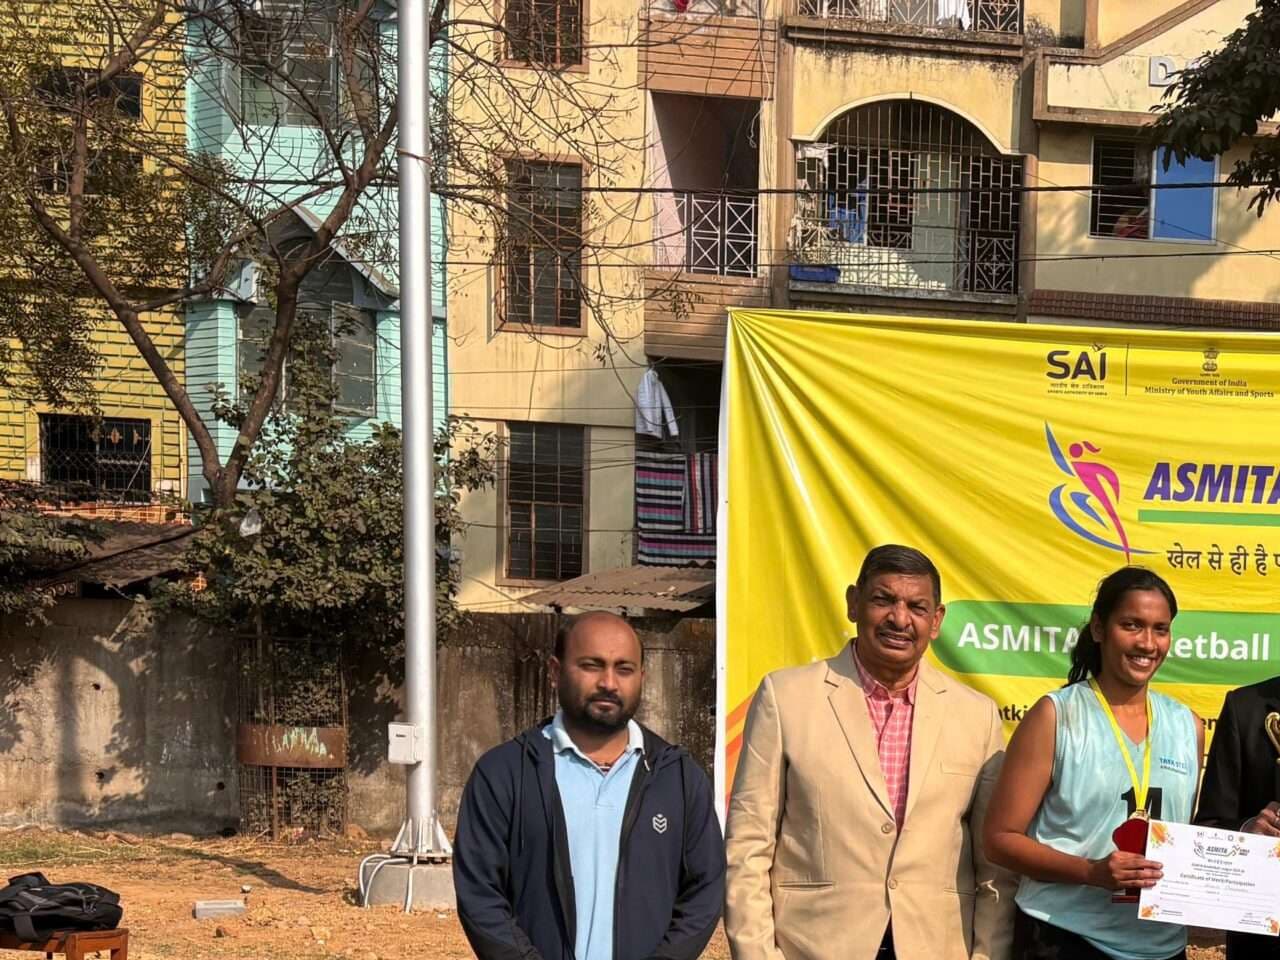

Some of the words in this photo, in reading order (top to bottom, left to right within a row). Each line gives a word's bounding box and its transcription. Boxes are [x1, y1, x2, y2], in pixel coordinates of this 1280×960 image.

[1145, 386, 1176, 396] Ministry
[1178, 386, 1186, 395] of
[1186, 388, 1207, 396] Youth
[1209, 388, 1233, 397] Affairs
[1235, 389, 1249, 397] and
[1251, 390, 1275, 399] Sports
[1172, 377, 1217, 387] Government
[1218, 378, 1226, 387] of
[1228, 379, 1247, 387] India
[1167, 542, 1202, 569] खेल
[1208, 543, 1224, 570] से
[1229, 545, 1249, 576] ही
[1254, 544, 1268, 576] है
[957, 622, 1080, 653] ASMITA
